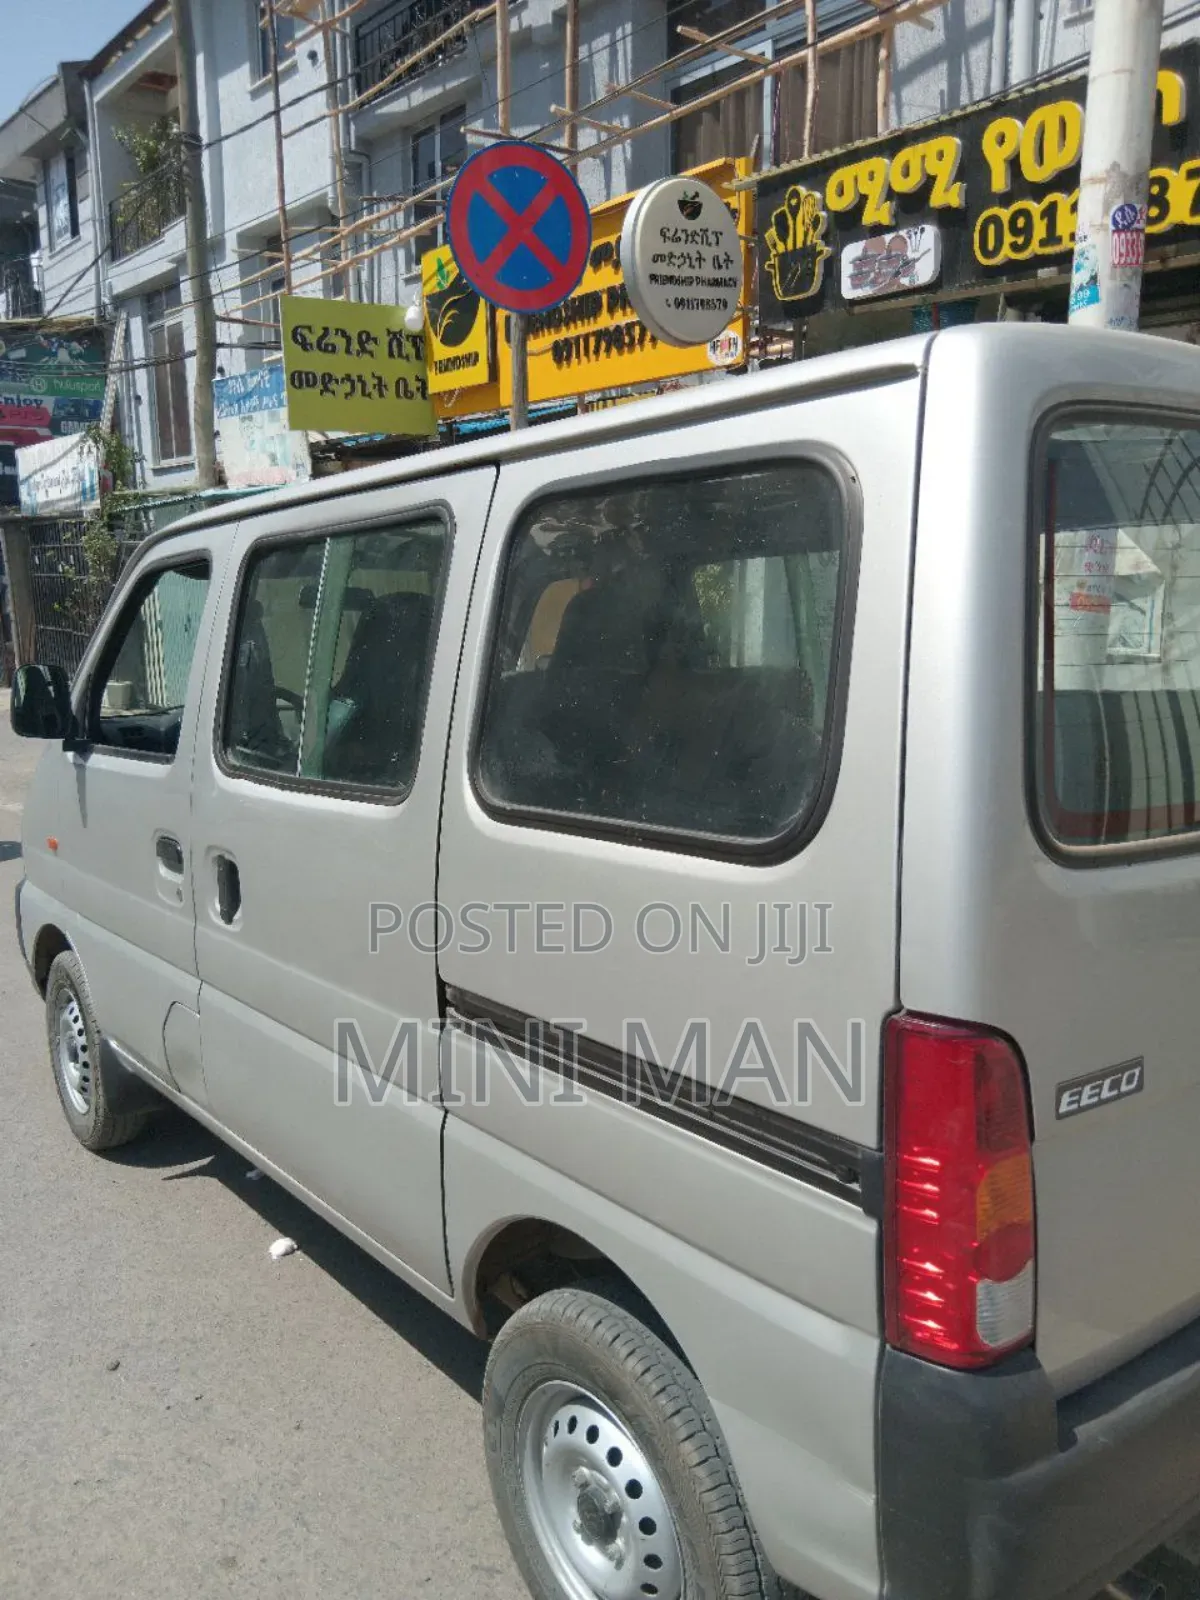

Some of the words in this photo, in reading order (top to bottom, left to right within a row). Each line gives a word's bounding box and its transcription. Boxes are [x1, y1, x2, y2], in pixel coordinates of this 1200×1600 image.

[826, 136, 966, 226] ሚሚ
[712, 251, 734, 270] ቤት
[0, 394, 43, 409] njoy
[1058, 1066, 1142, 1114] EECO
